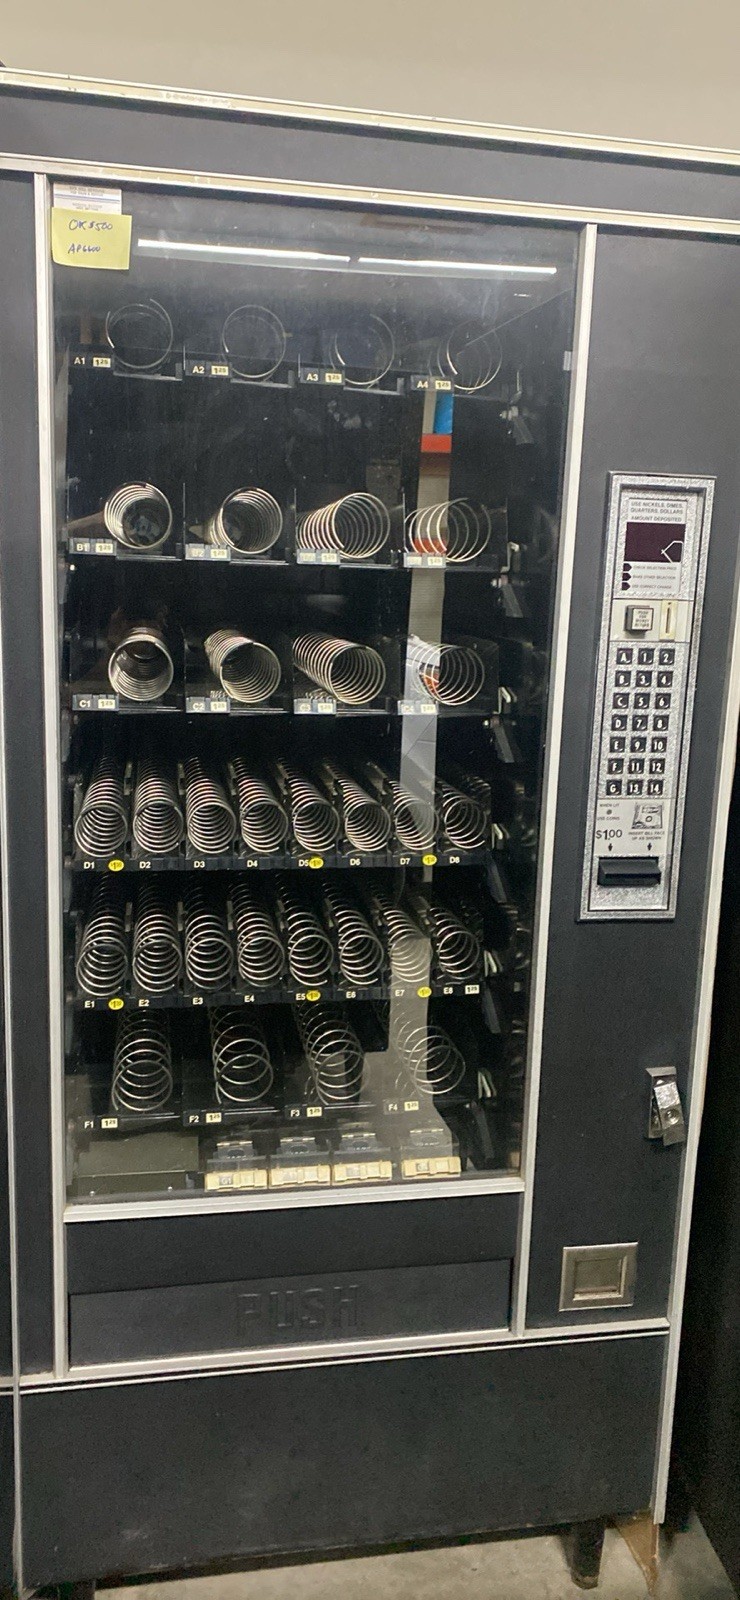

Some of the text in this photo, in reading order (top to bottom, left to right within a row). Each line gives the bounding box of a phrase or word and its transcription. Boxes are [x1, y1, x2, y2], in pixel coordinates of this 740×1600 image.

[74, 357, 86, 365] A1
[192, 365, 205, 374] A2
[306, 373, 319, 381] A3
[416, 380, 429, 388] A4
[76, 543, 88, 551] B1
[79, 699, 91, 708] C1
[654, 741, 663, 750] 10
[632, 763, 640, 771] 11
[652, 763, 661, 771] 12
[630, 784, 638, 792] 13
[650, 784, 659, 792] 14
[193, 860, 205, 868] D3
[246, 860, 258, 868] D4
[298, 859, 309, 867] D5
[350, 858, 361, 866] D6
[400, 857, 411, 865] D7
[449, 856, 460, 864] D8
[139, 861, 151, 869] D2
[345, 991, 356, 999] E6
[395, 989, 406, 997] E7
[443, 987, 454, 995] E8
[138, 999, 149, 1007] E2
[192, 997, 204, 1005] E3
[244, 995, 255, 1003] E4
[84, 1000, 95, 1008] E1
[189, 1115, 199, 1123] F2
[84, 1121, 94, 1129] F1
[237, 1284, 360, 1335] PUSH
